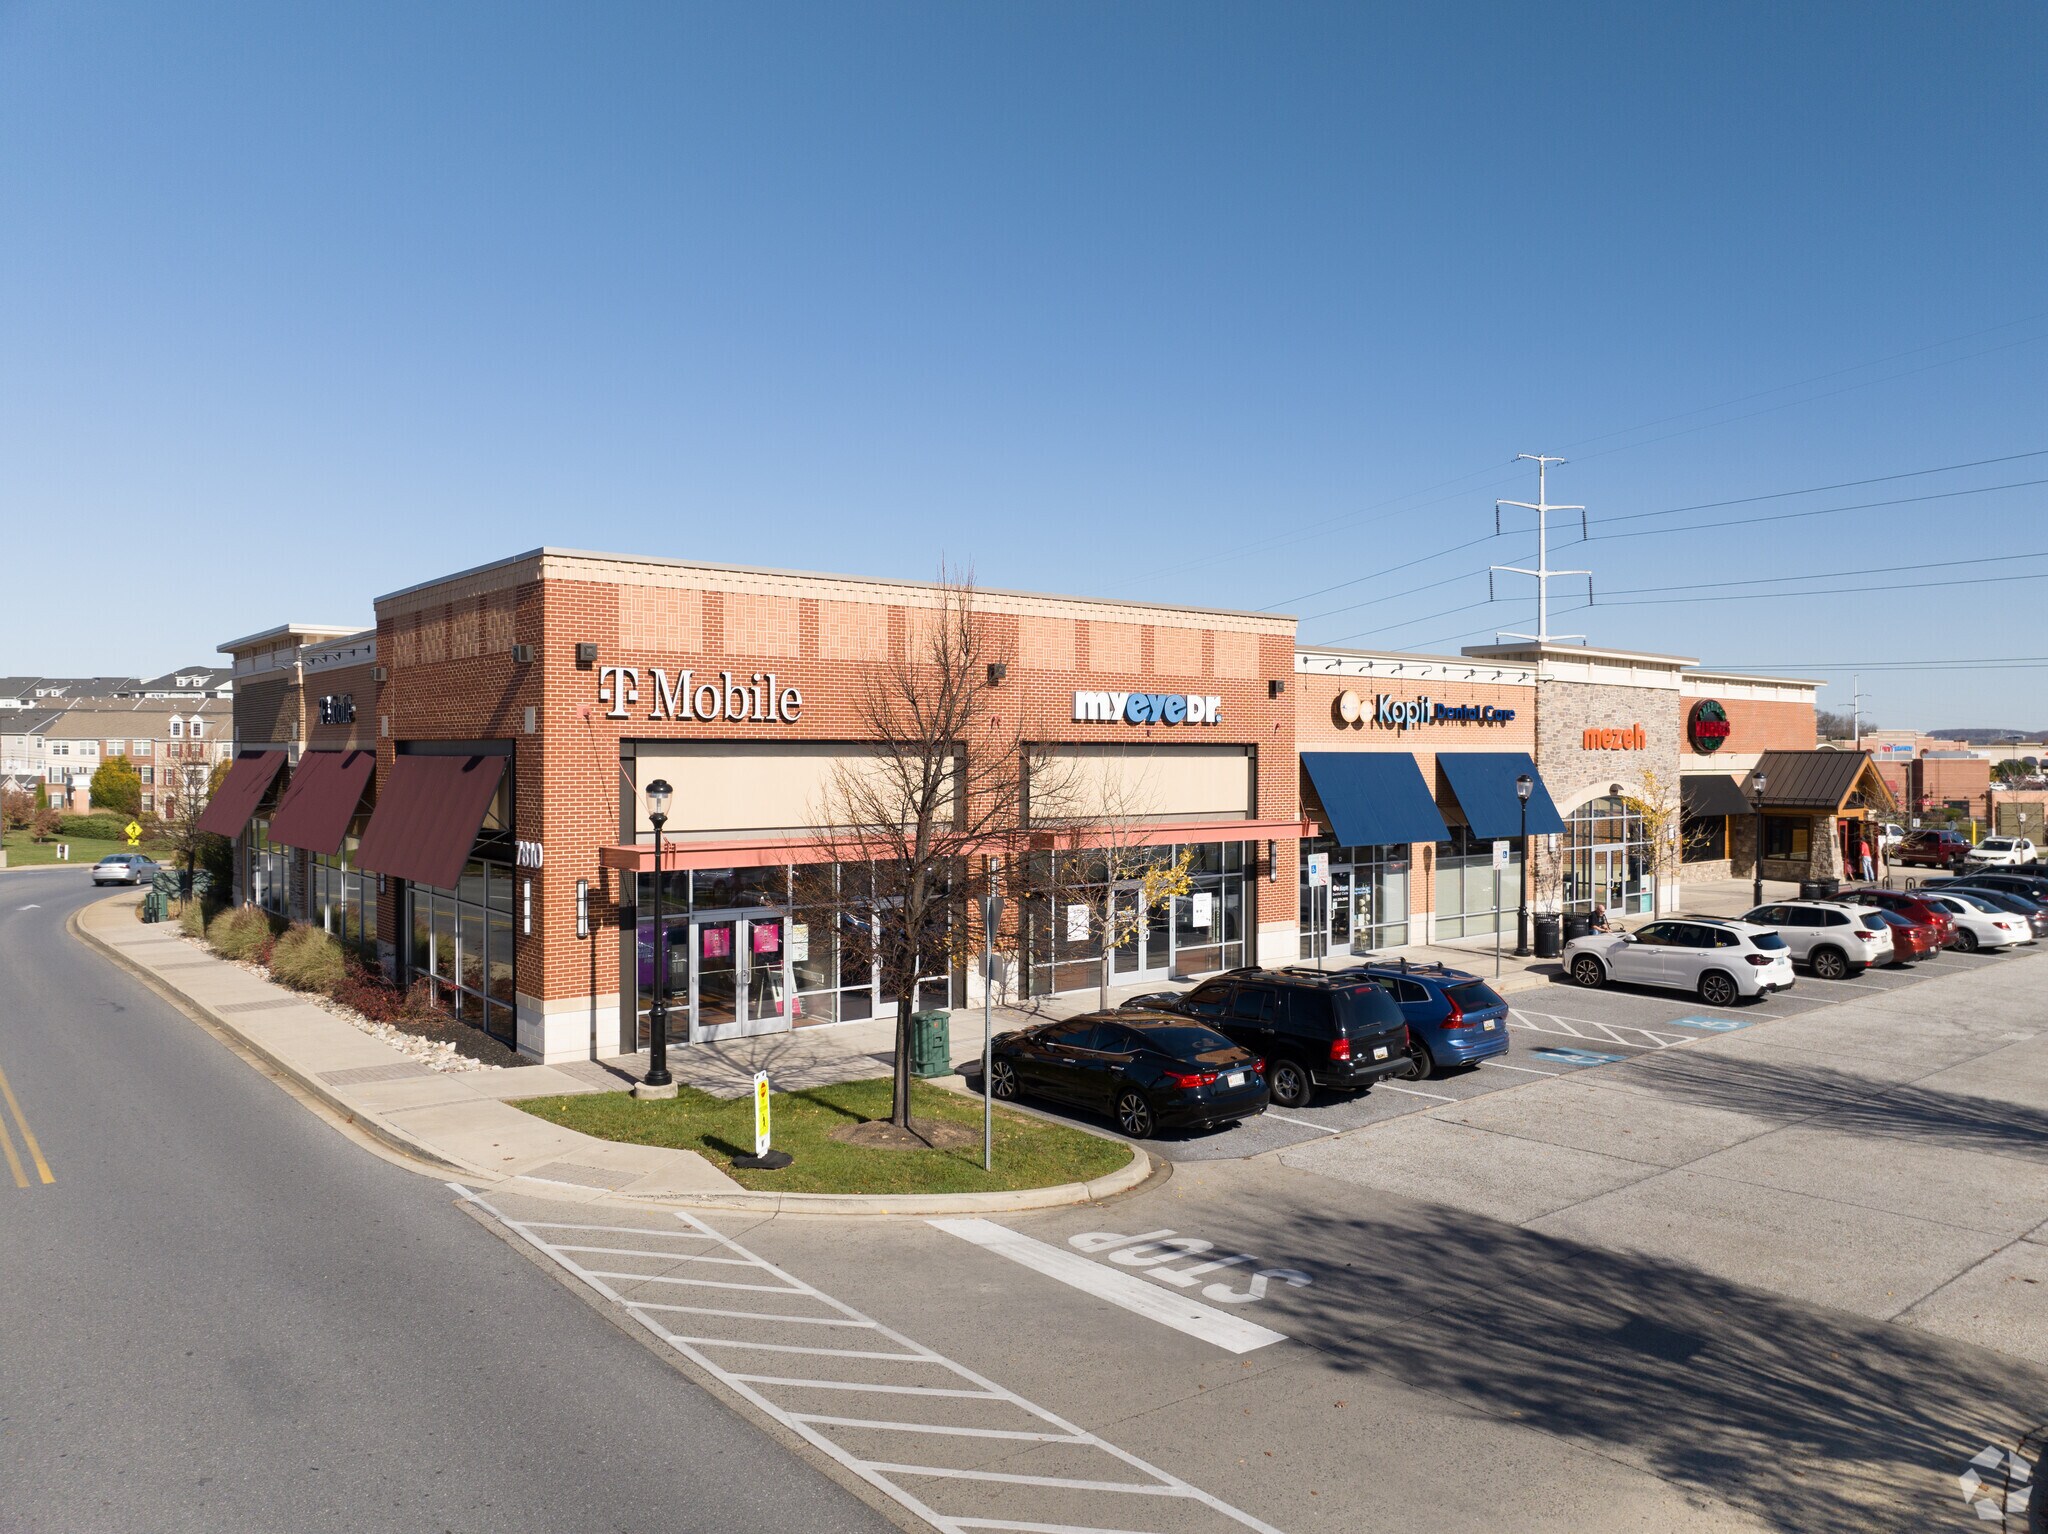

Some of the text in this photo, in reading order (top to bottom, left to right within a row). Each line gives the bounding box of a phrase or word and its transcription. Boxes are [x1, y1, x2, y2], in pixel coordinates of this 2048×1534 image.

[600, 666, 803, 722] T Mobile
[1378, 694, 1516, 731] Kopit Dental Care
[1583, 722, 1646, 750] mezeh
[515, 841, 543, 868] 7810
[1067, 1229, 1313, 1304] STOP
